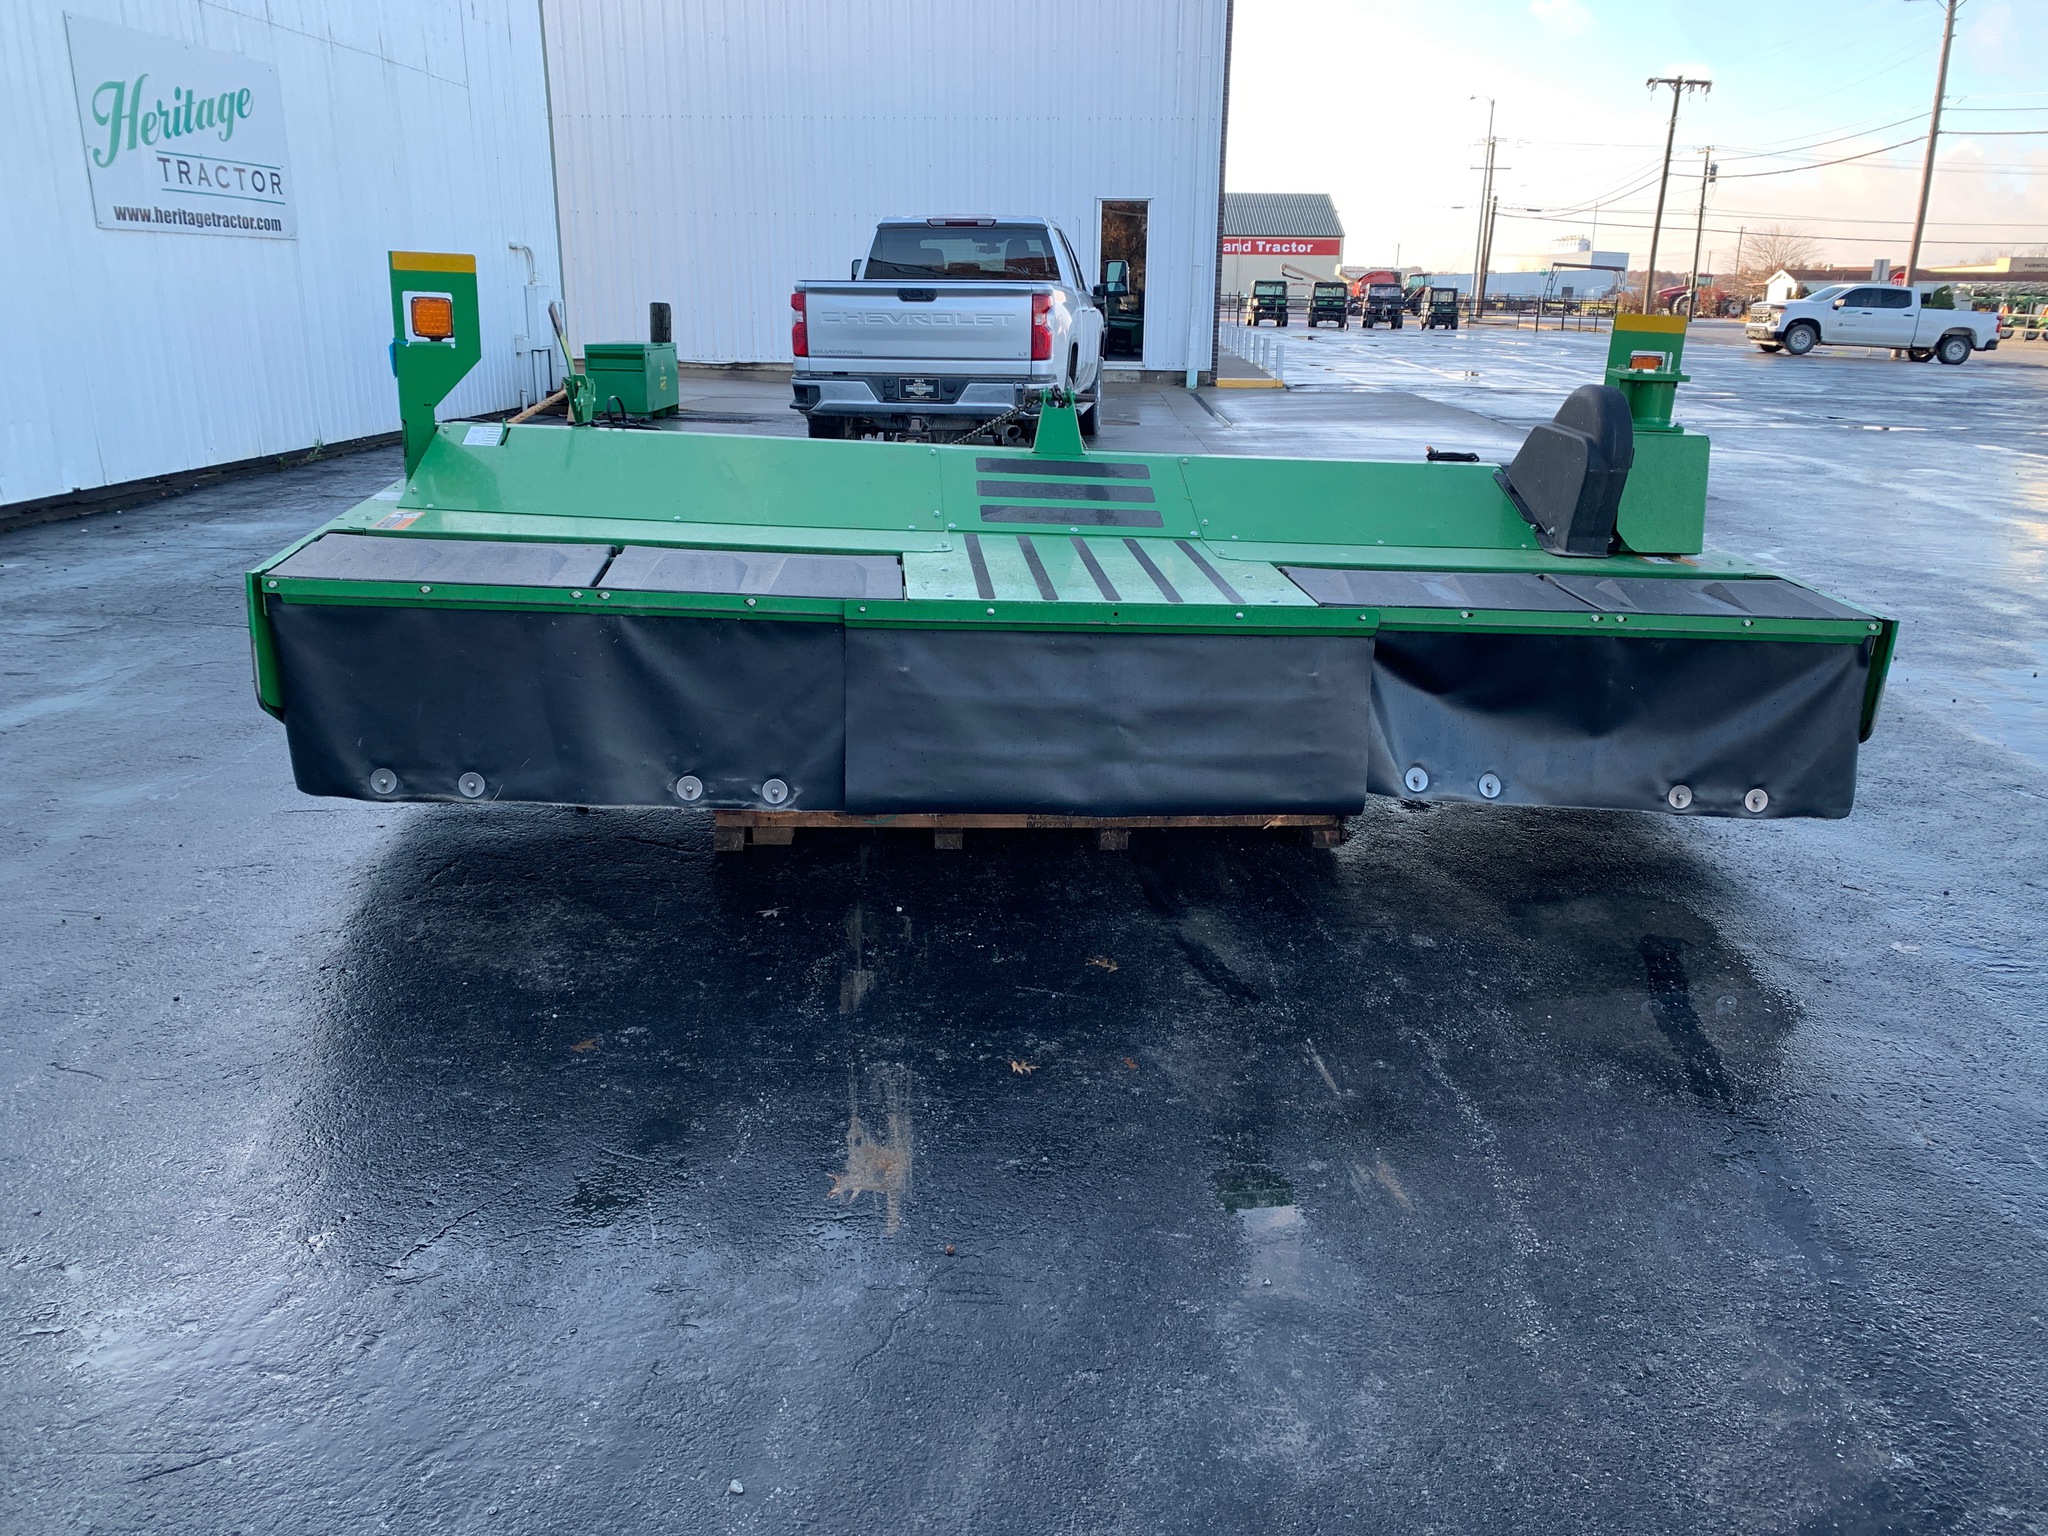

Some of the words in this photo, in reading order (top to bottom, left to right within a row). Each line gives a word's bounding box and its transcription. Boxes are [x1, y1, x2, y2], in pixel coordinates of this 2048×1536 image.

[92, 73, 254, 168] Heritage
[156, 156, 284, 195] TRACTOR
[113, 205, 282, 232] www.heritagetractor.com
[1256, 241, 1314, 253] Tractor
[821, 311, 1016, 327] CHEVROLET
